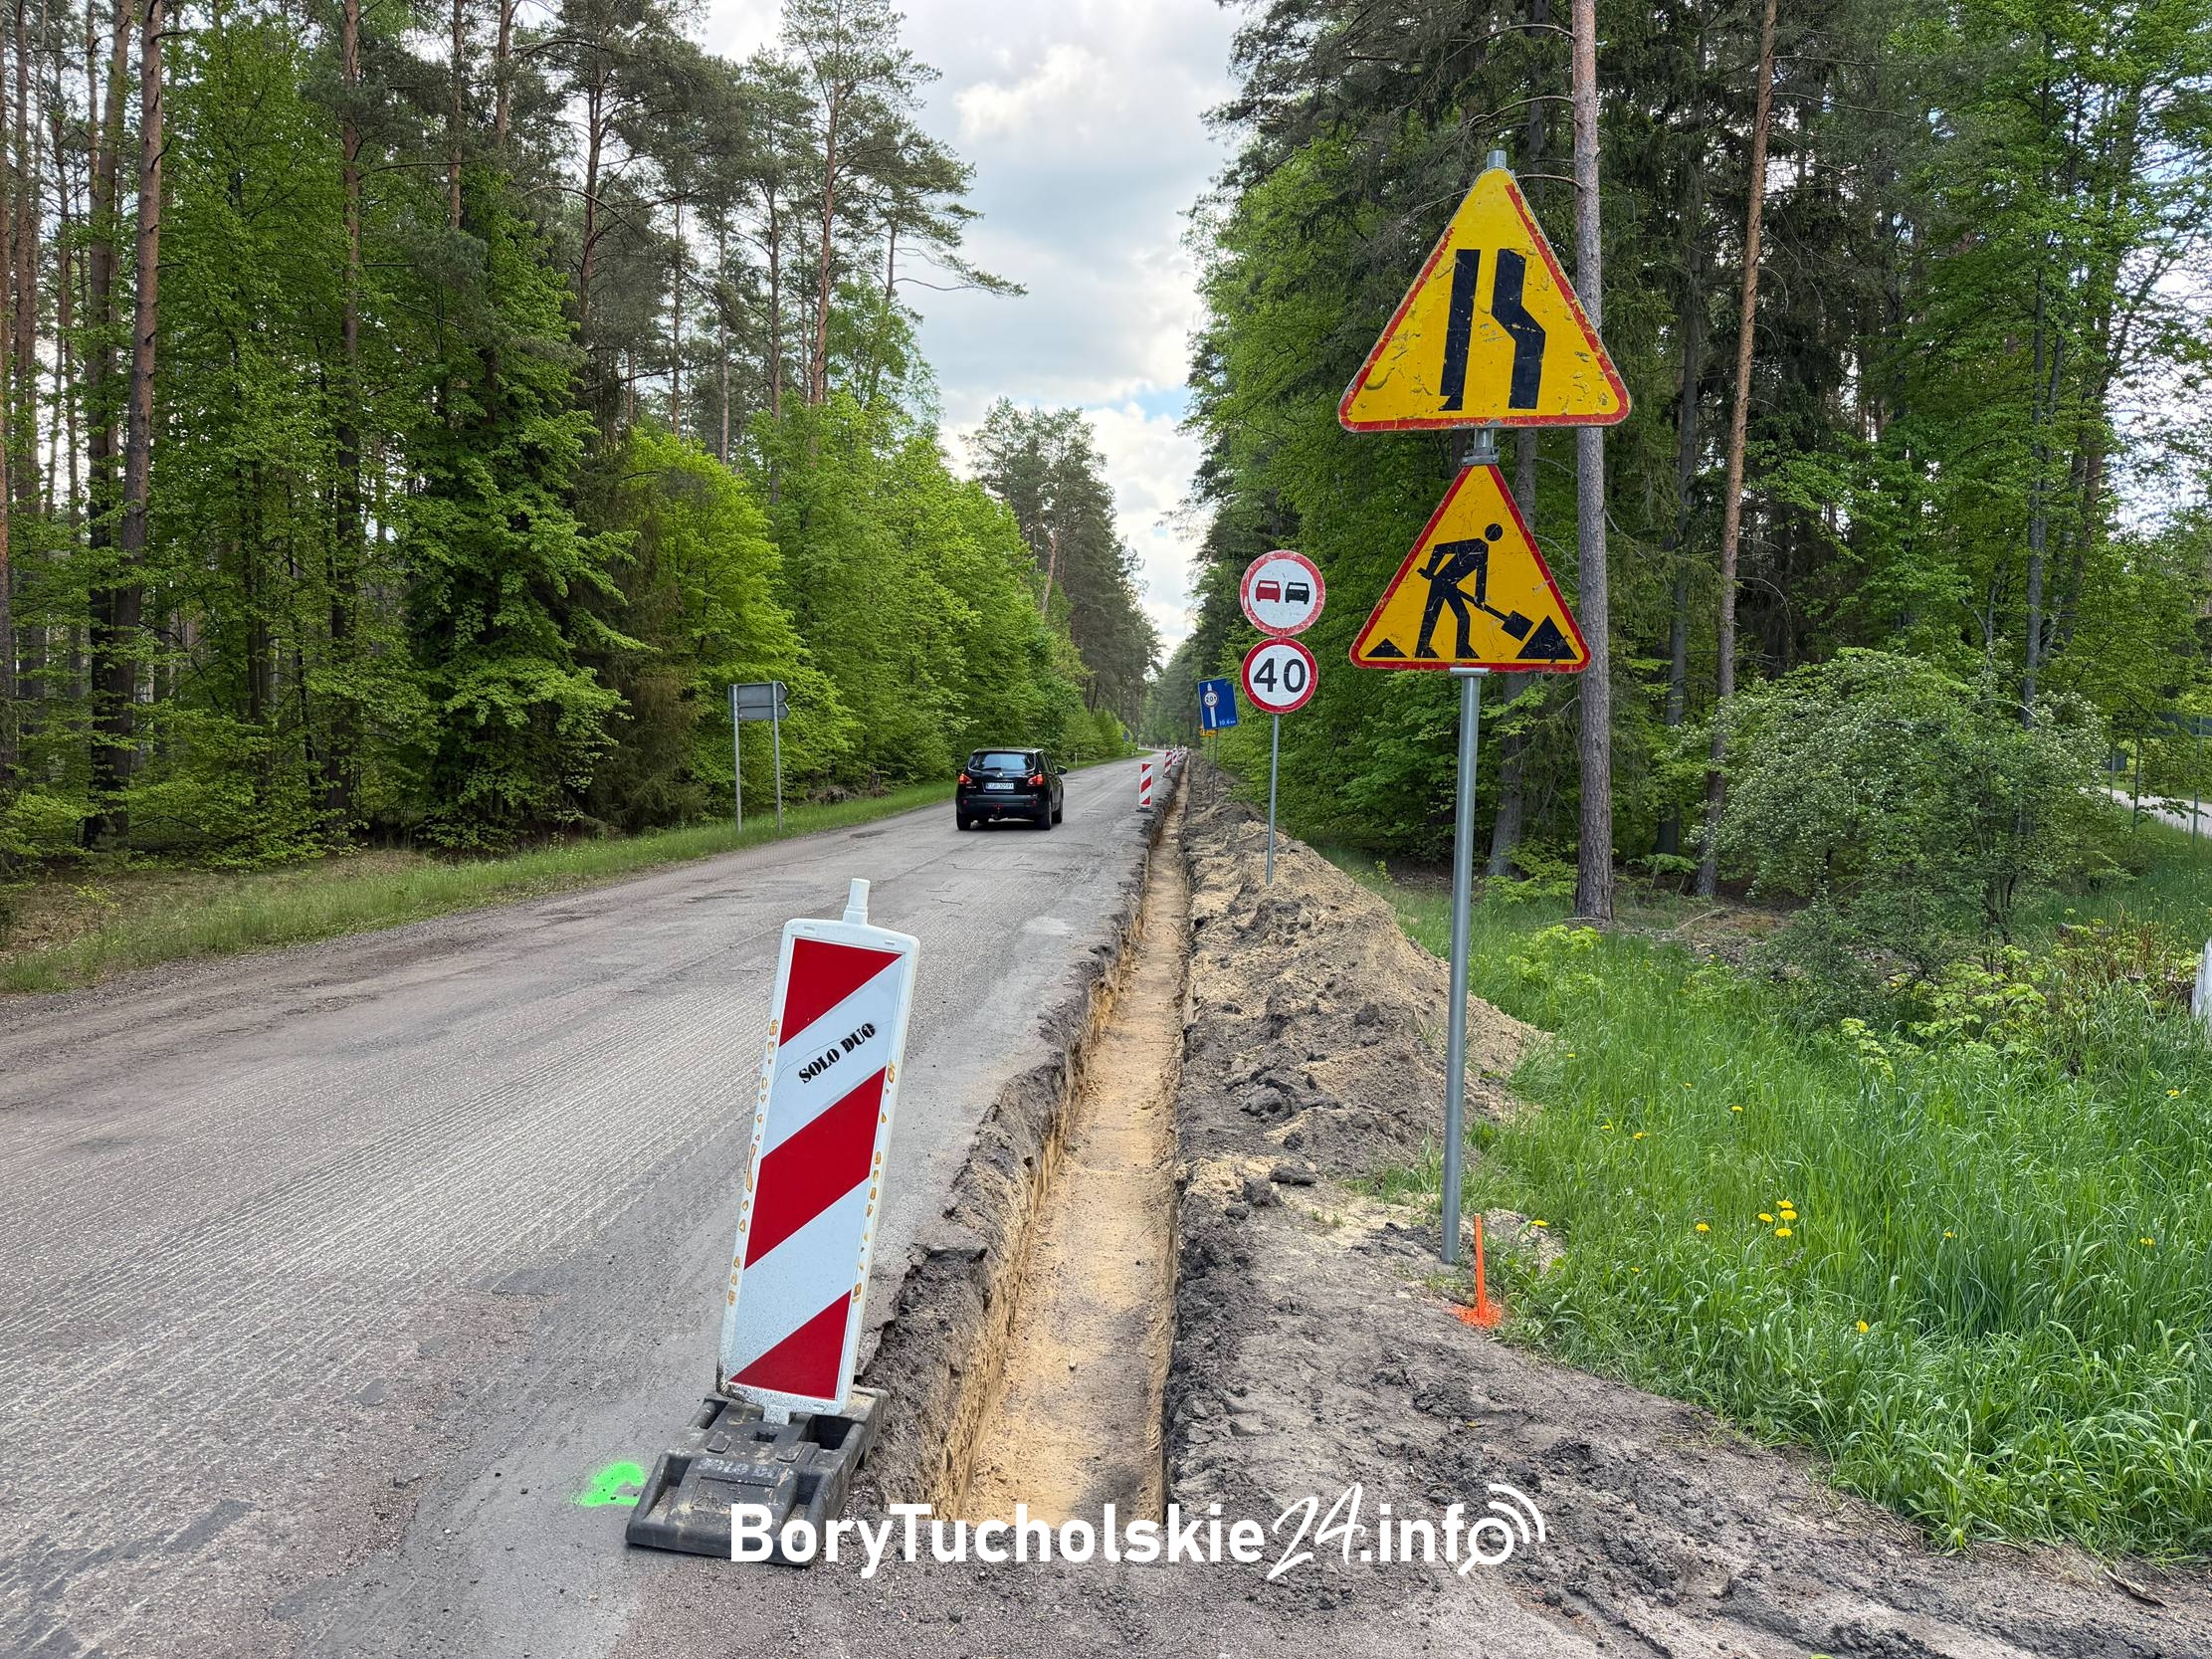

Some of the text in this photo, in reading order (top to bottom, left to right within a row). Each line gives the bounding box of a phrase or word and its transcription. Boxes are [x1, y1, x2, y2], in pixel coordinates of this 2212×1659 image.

[1254, 658, 1306, 693] 40
[798, 1022, 877, 1084] SOLO DUO
